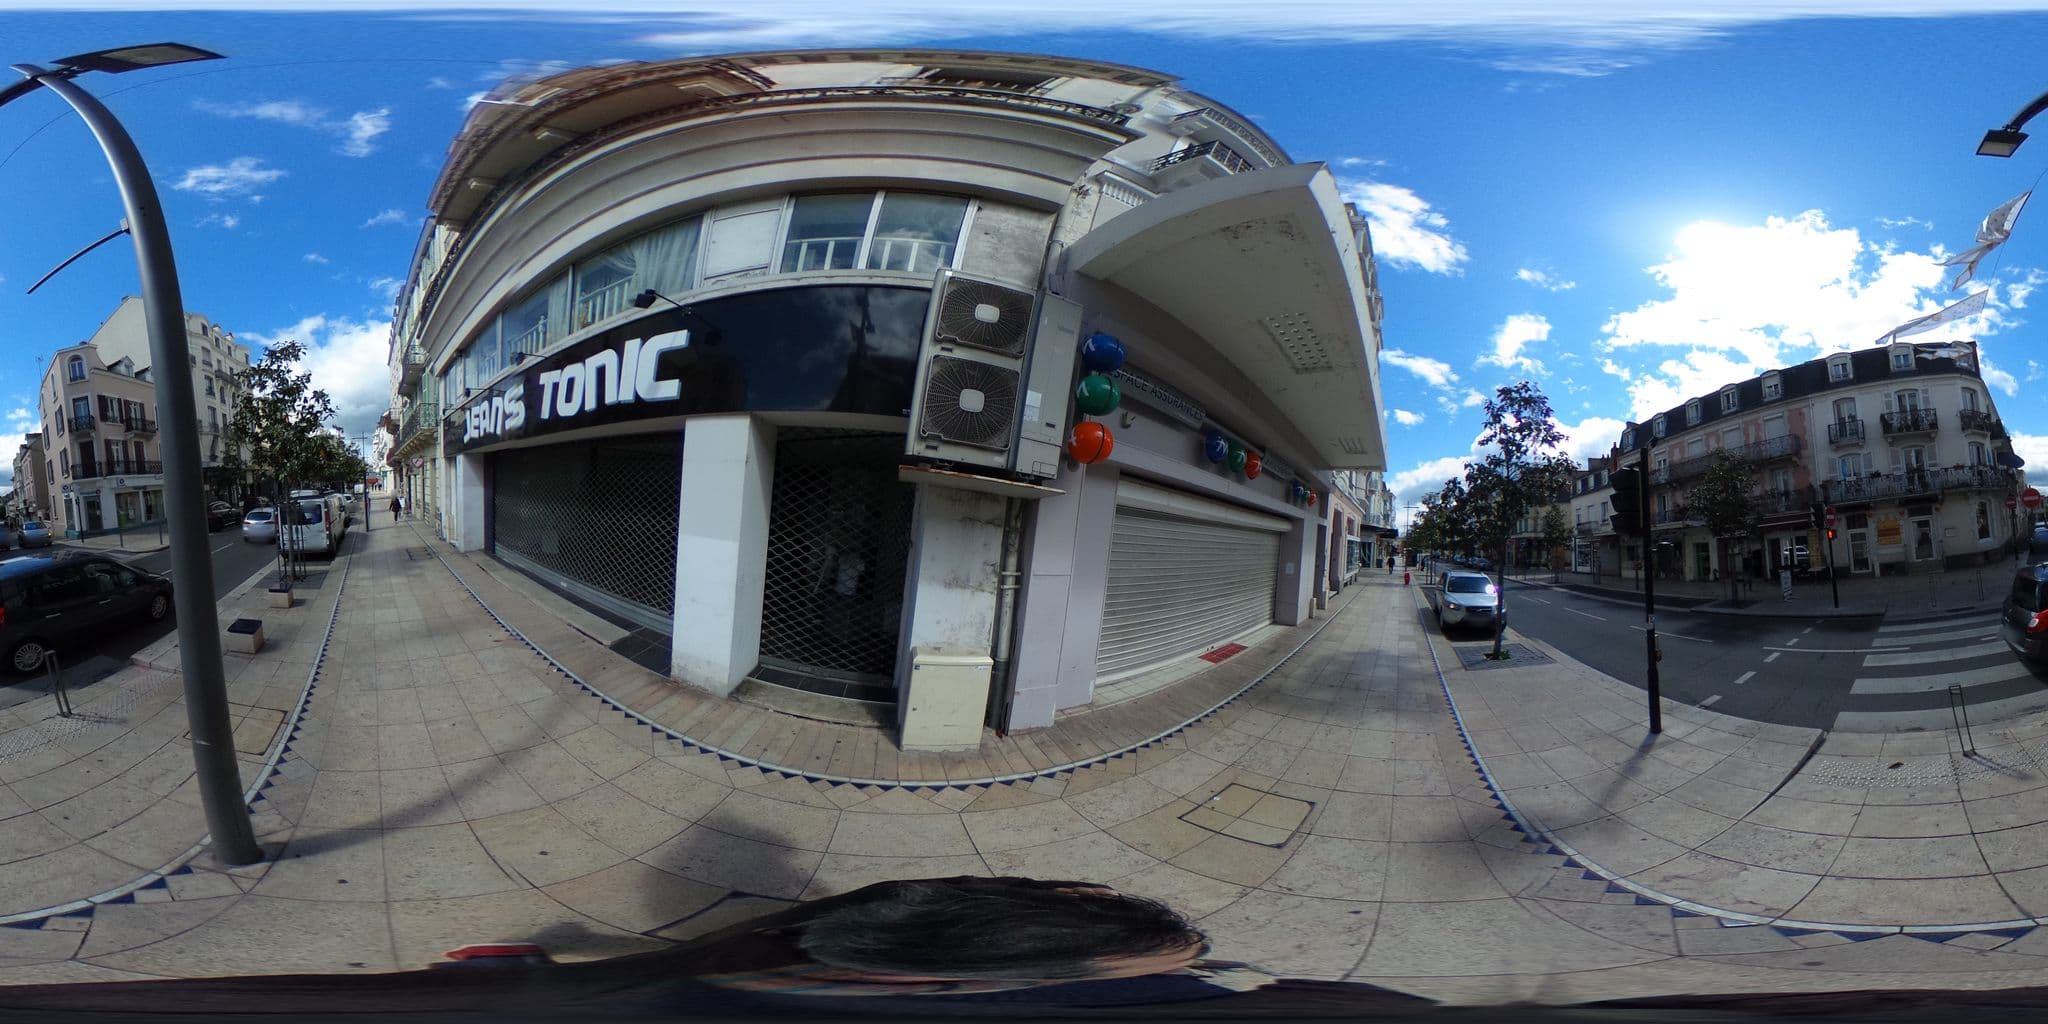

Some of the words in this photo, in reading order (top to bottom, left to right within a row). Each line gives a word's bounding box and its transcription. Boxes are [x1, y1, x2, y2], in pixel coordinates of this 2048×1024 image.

[463, 384, 526, 444] JEANS
[539, 329, 688, 419] TONIC
[1151, 384, 1207, 420] ASSURANCES
